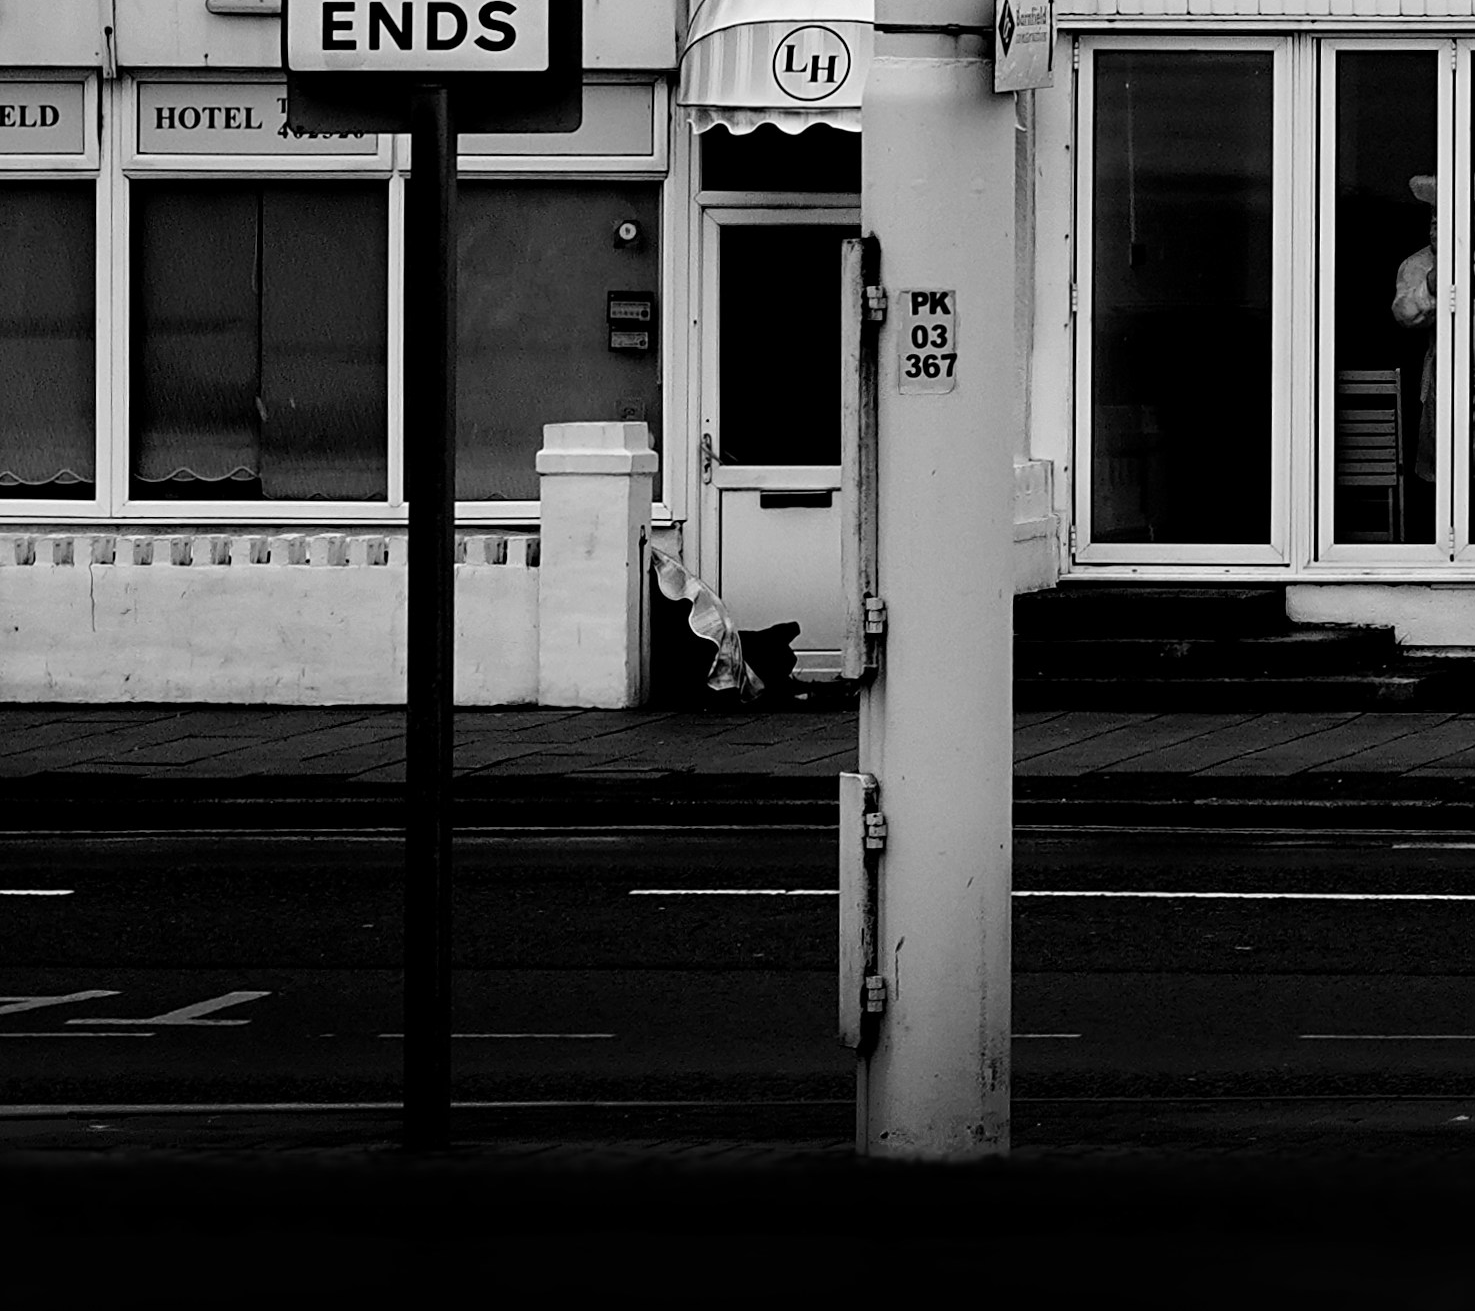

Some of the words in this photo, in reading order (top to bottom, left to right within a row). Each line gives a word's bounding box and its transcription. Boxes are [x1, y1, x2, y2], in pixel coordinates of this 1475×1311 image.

[323, 1, 516, 51] ENDS
[155, 107, 262, 129] HOTEL
[911, 291, 951, 315] PK
[911, 324, 947, 349] 03
[905, 353, 957, 378] 367
